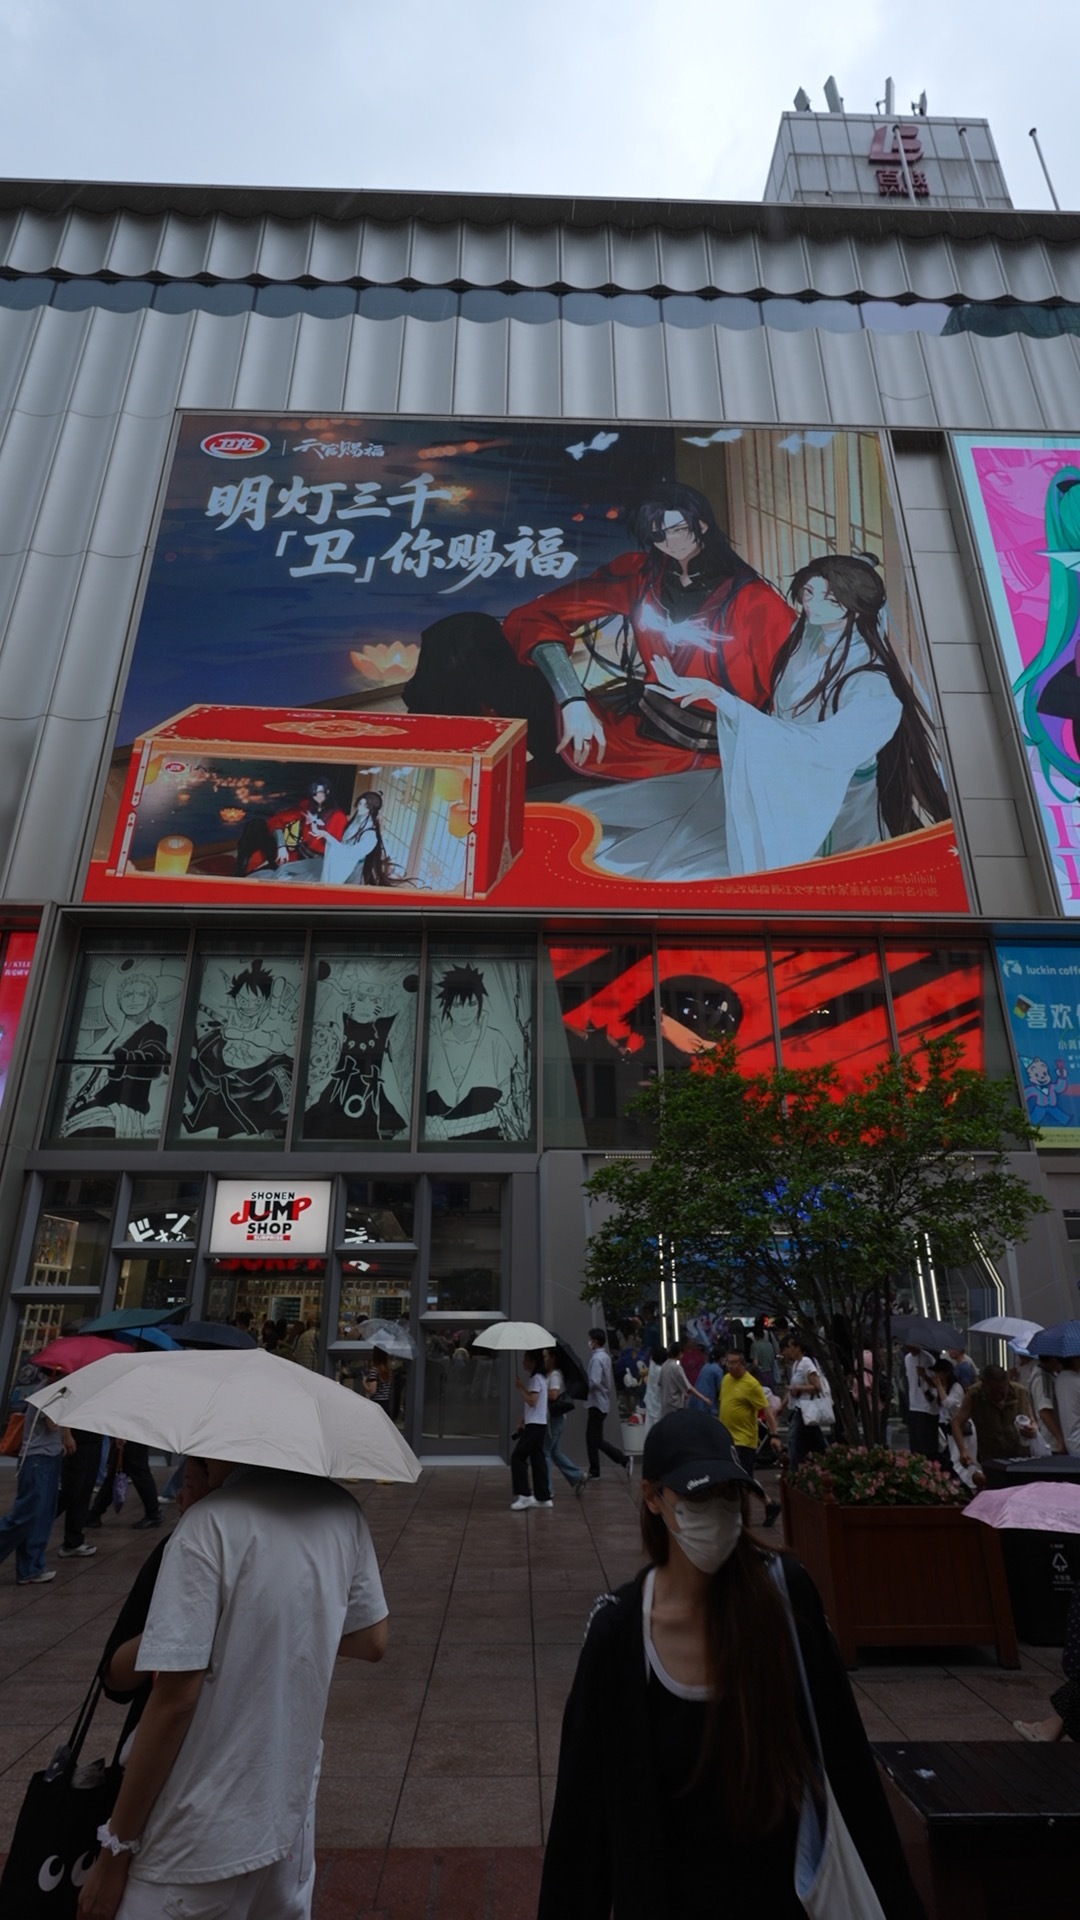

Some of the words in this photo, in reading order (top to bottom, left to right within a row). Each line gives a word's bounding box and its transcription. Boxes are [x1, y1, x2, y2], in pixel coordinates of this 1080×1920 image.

[293, 438, 386, 461] 天官赐福
[205, 473, 453, 532] 明灯三千
[1026, 964, 1057, 976] luckin
[1026, 1003, 1080, 1030] 喜欢
[251, 1191, 295, 1200] SHONEN
[230, 1197, 312, 1225] JUMP
[247, 1222, 292, 1235] SHOP
